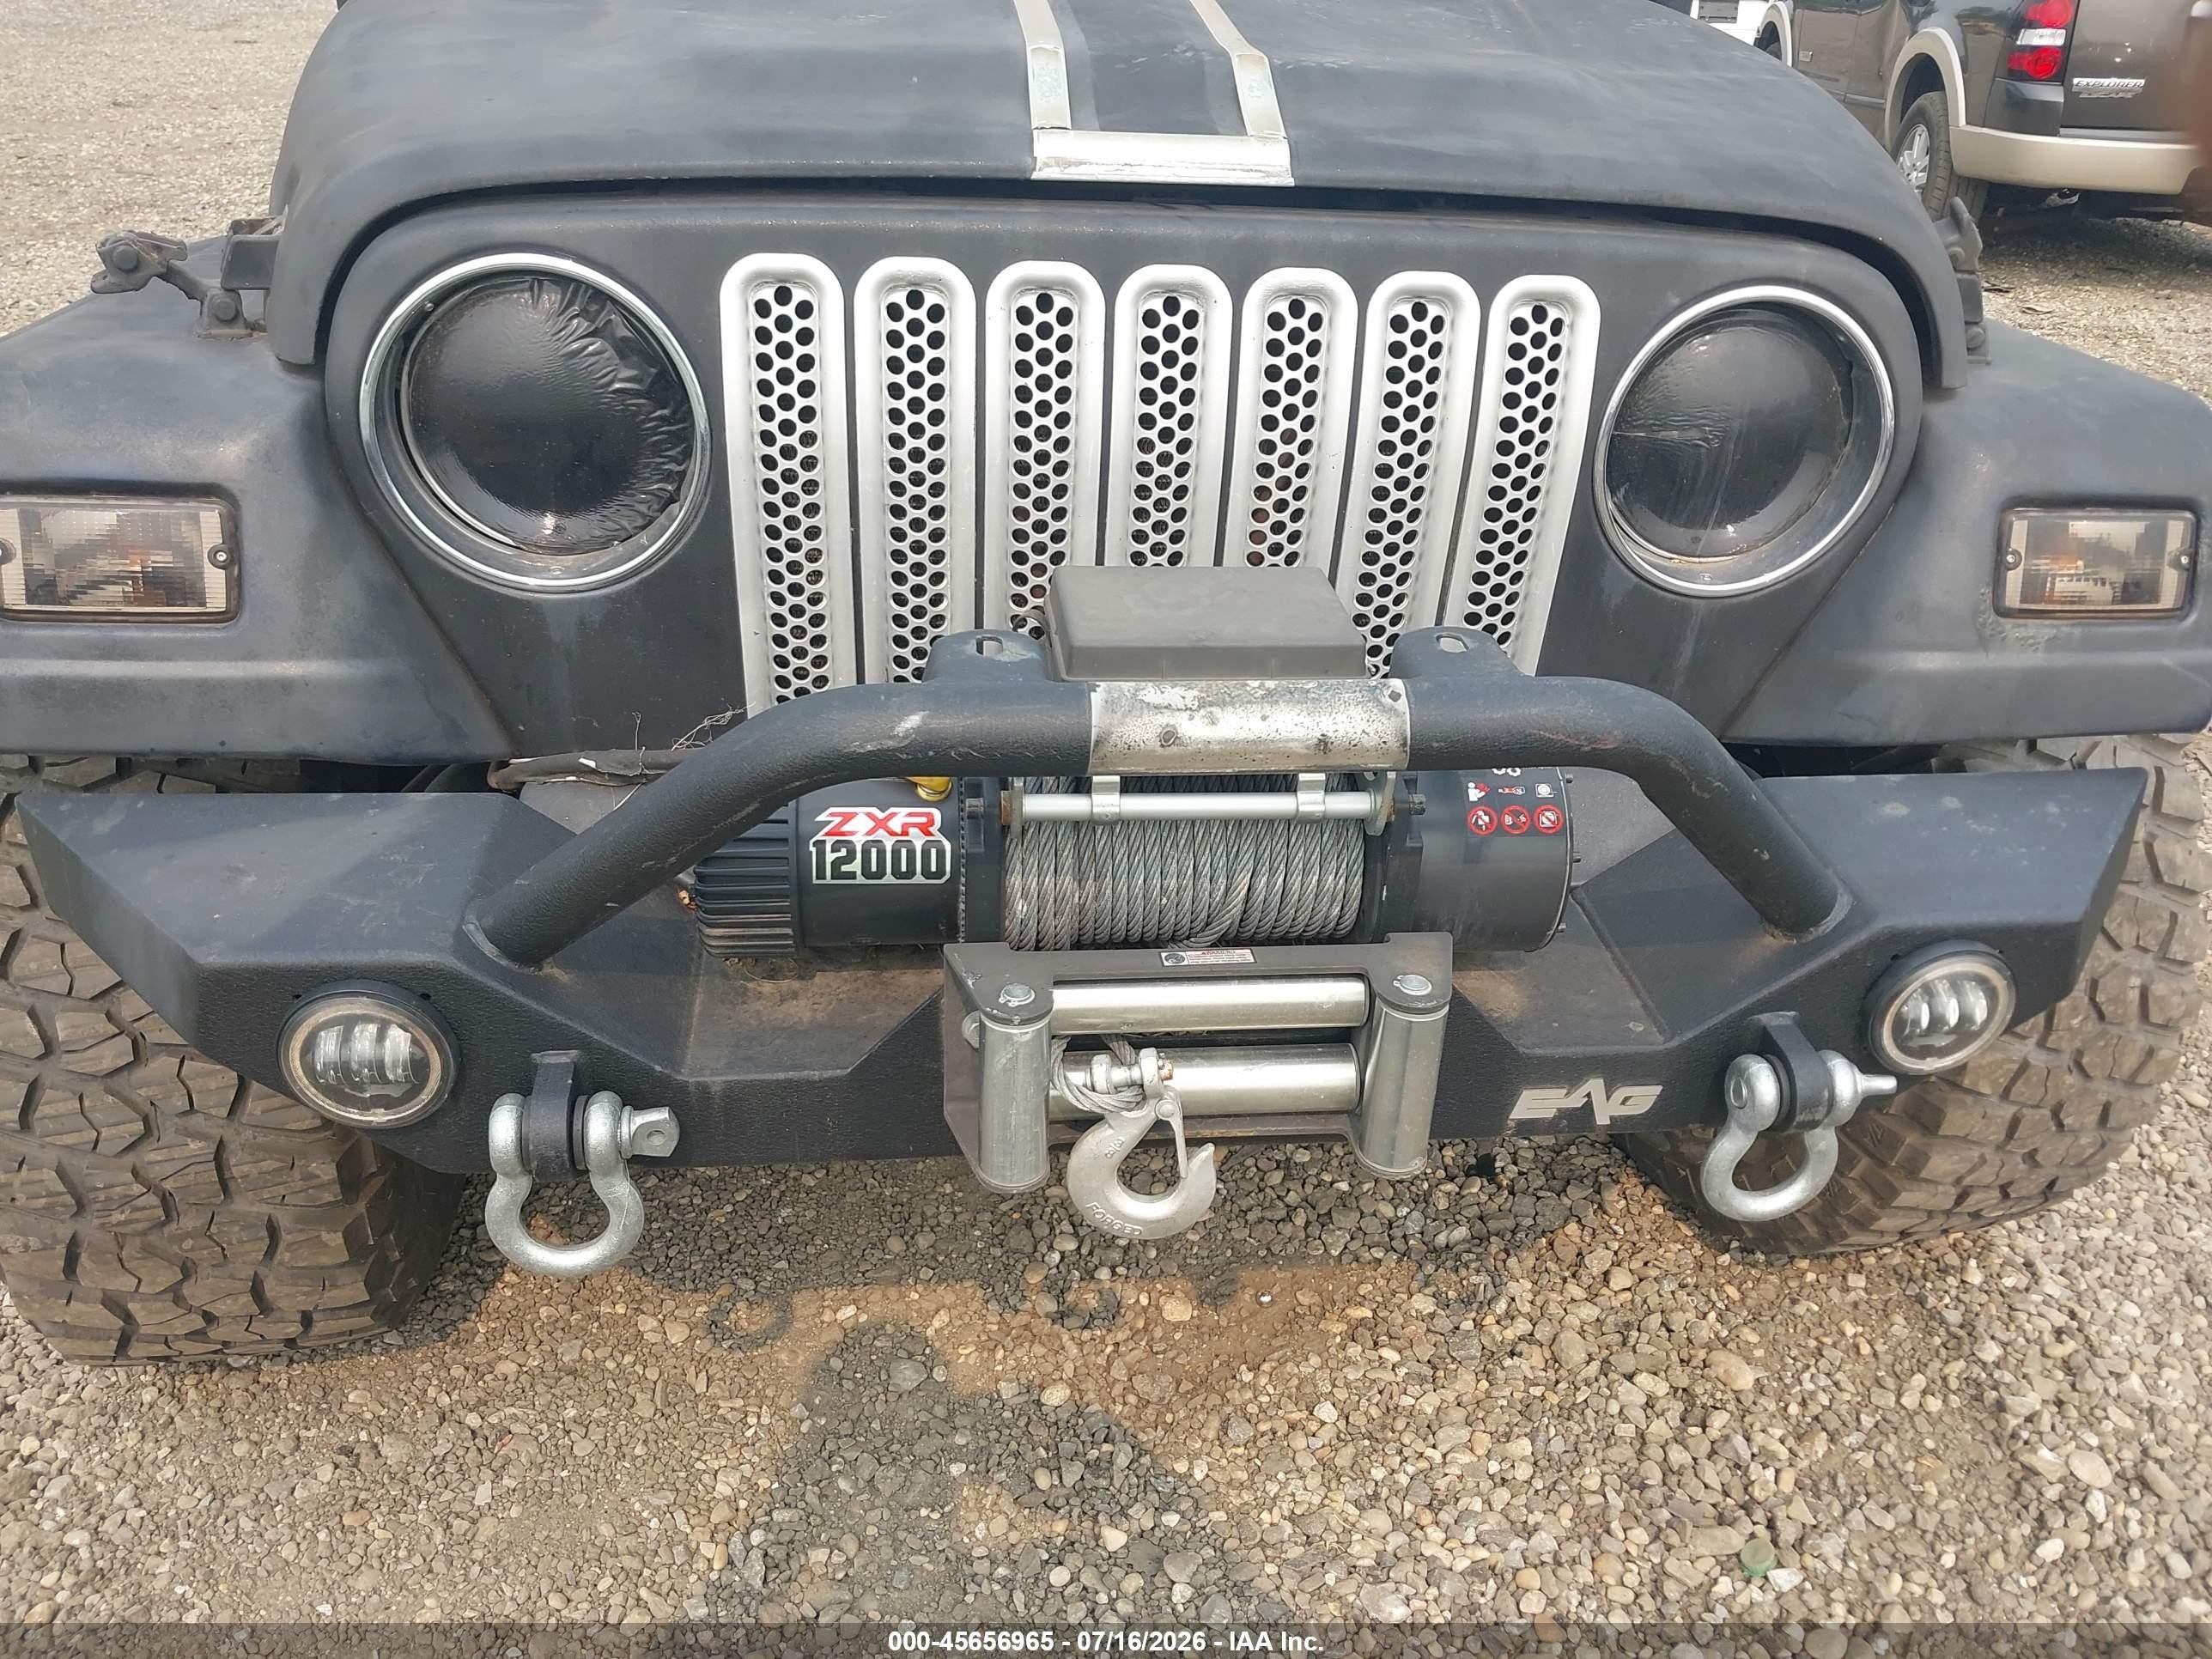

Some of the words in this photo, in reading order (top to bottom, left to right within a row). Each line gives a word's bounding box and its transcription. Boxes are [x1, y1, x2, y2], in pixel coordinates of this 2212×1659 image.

[2073, 78, 2145, 89] EXPLORER
[822, 811, 935, 836] ZXR
[812, 839, 947, 880] 12000
[1085, 1201, 1142, 1235] FORGED
